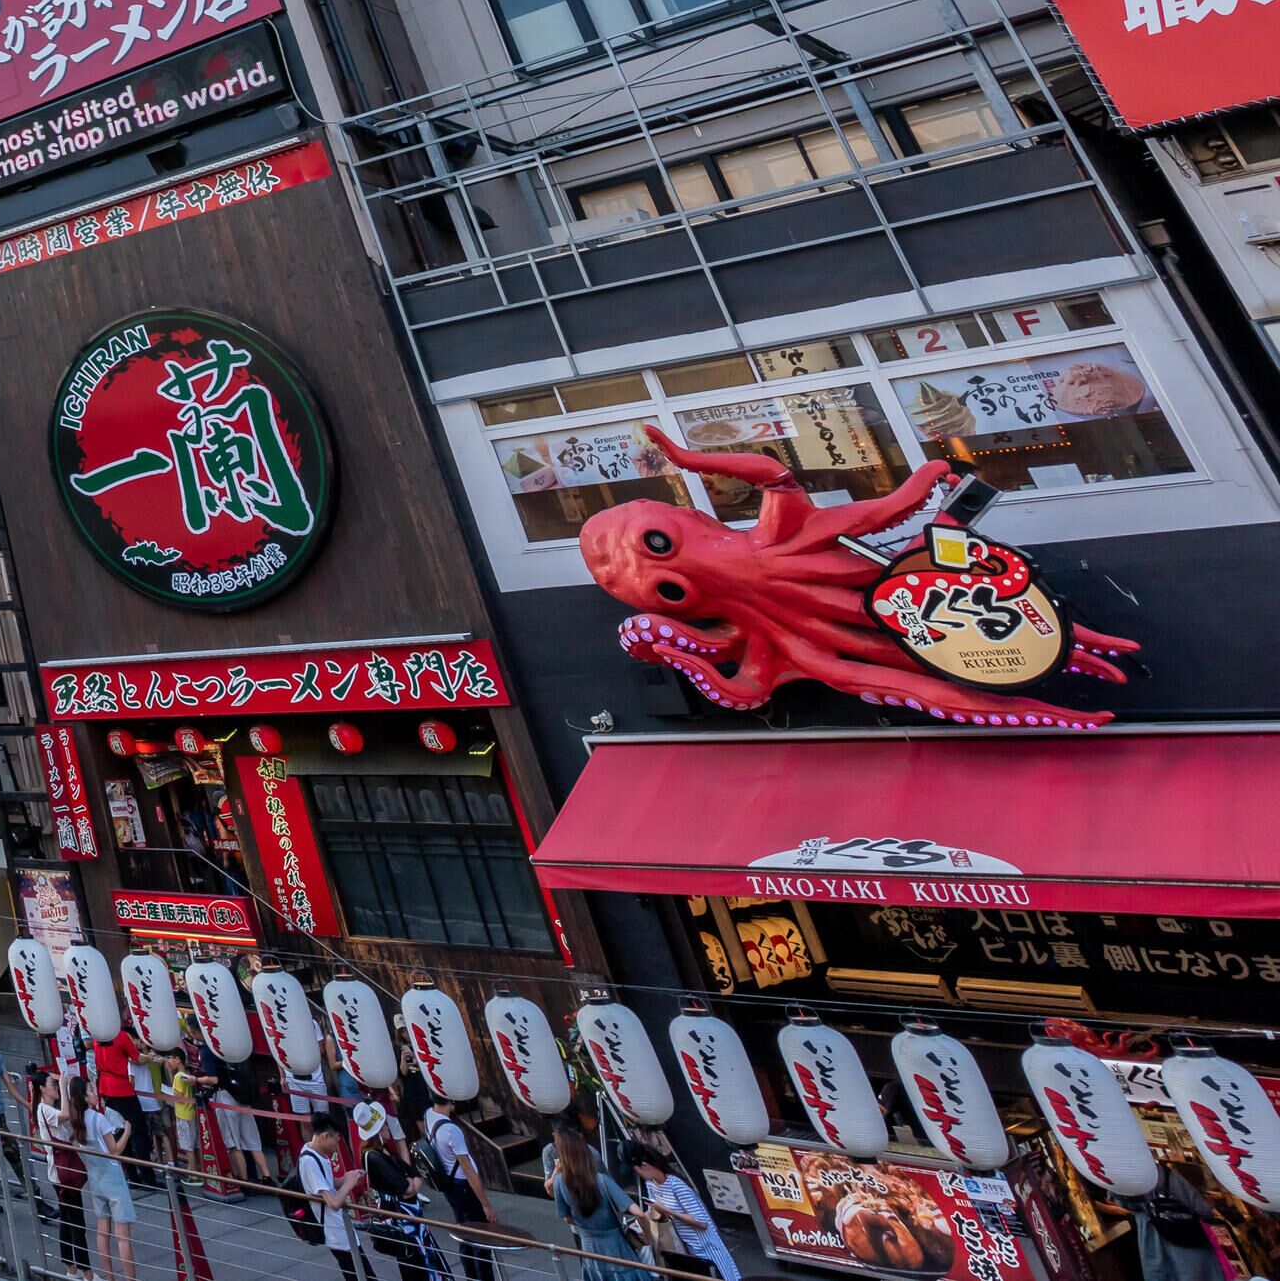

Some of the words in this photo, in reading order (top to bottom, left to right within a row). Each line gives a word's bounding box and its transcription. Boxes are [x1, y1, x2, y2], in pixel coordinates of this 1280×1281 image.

[47, 126, 104, 169] shop
[107, 116, 132, 140] in
[135, 99, 180, 133] the
[182, 62, 276, 110] world.
[48, 84, 137, 135] visited
[917, 328, 948, 354] 2
[1011, 308, 1041, 336] F
[60, 324, 153, 432] ICHIRAN
[1006, 369, 1061, 385] Greentea
[1012, 383, 1040, 394] Cafe
[69, 339, 315, 536] 一蘭
[593, 432, 632, 446] Greentea
[751, 420, 794, 439] 2F
[597, 444, 617, 454] Cafe
[171, 542, 288, 596] 昭和35年創業
[920, 585, 1023, 641] くくる
[959, 648, 1021, 659] DOTONBORI
[962, 656, 1027, 670] KUKURU
[50, 648, 500, 715] 天然とんこつラーメン専門店
[823, 838, 947, 868] くくる
[746, 876, 888, 901] TAKO-YAKI
[909, 882, 1031, 906] KUKURU
[116, 899, 209, 925] お土産販売所
[968, 908, 1076, 937] 入口は
[979, 937, 1091, 970] ビル裏
[762, 1171, 800, 1190] NO.1
